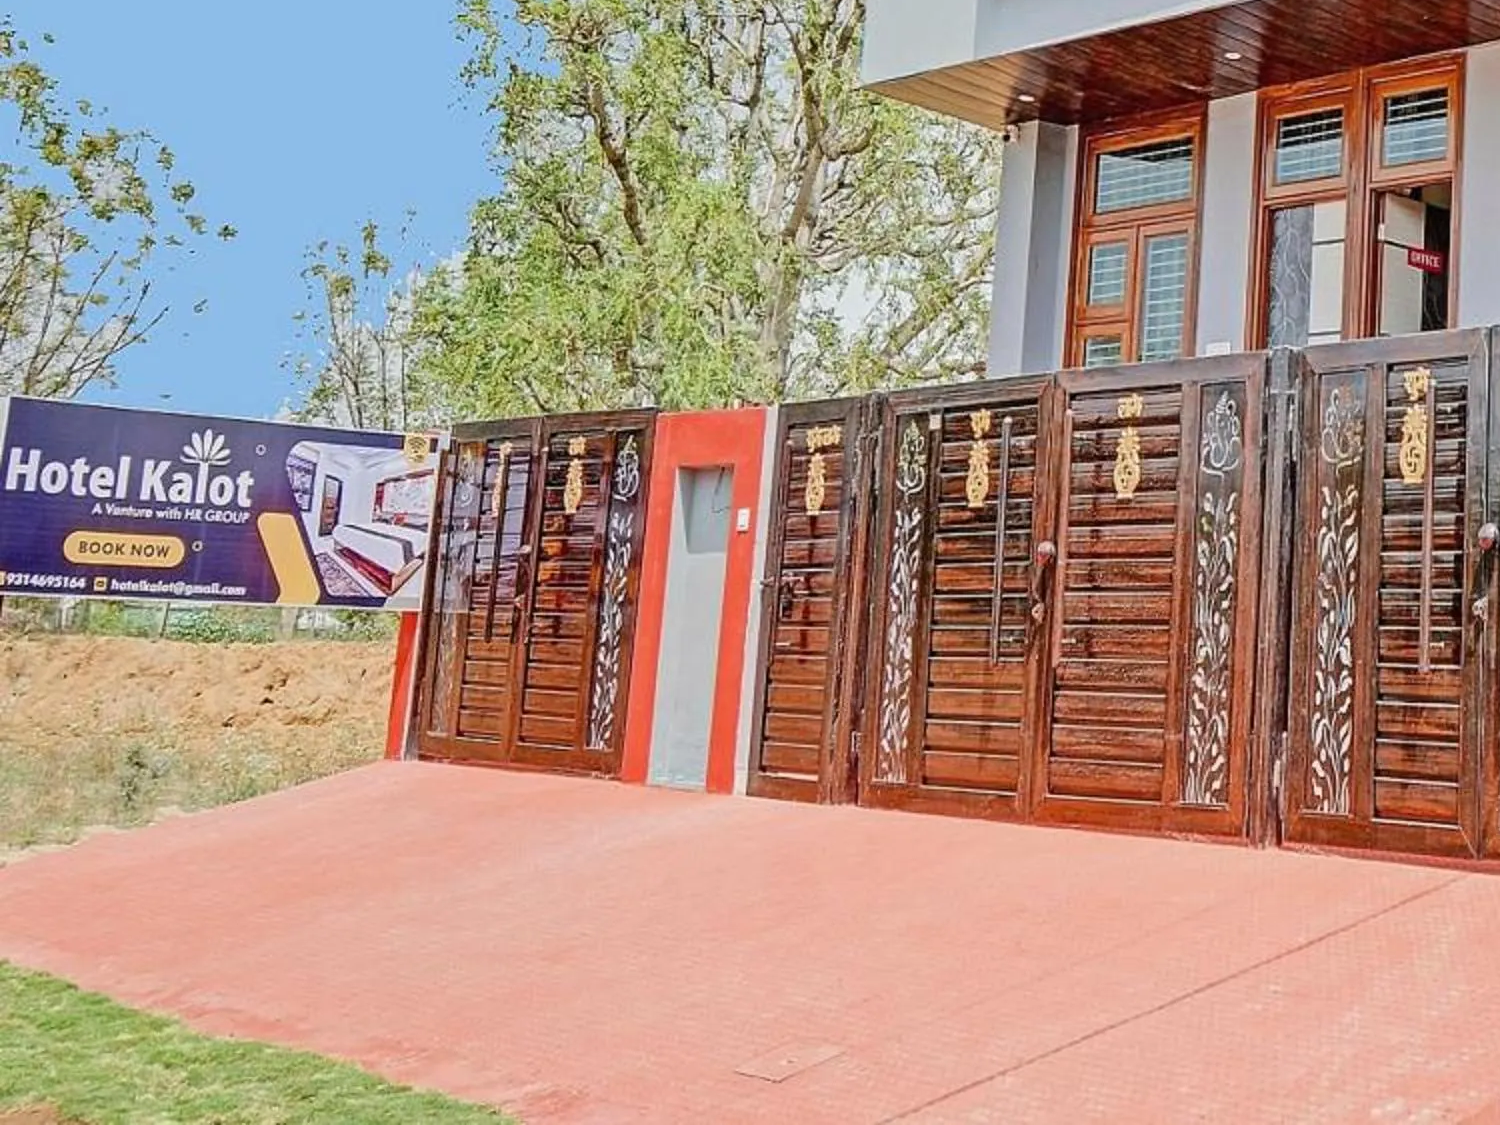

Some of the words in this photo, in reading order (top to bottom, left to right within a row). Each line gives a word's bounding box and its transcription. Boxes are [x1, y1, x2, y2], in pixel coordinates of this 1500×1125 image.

[5, 446, 131, 500] Hotel
[139, 458, 255, 508] Kalot
[91, 503, 103, 515] A
[105, 503, 153, 519] Venture
[155, 506, 182, 521] with
[205, 509, 251, 525] GROUP
[78, 540, 126, 556] BOOK
[130, 544, 171, 559] NOW
[7, 572, 86, 589] 9314695164
